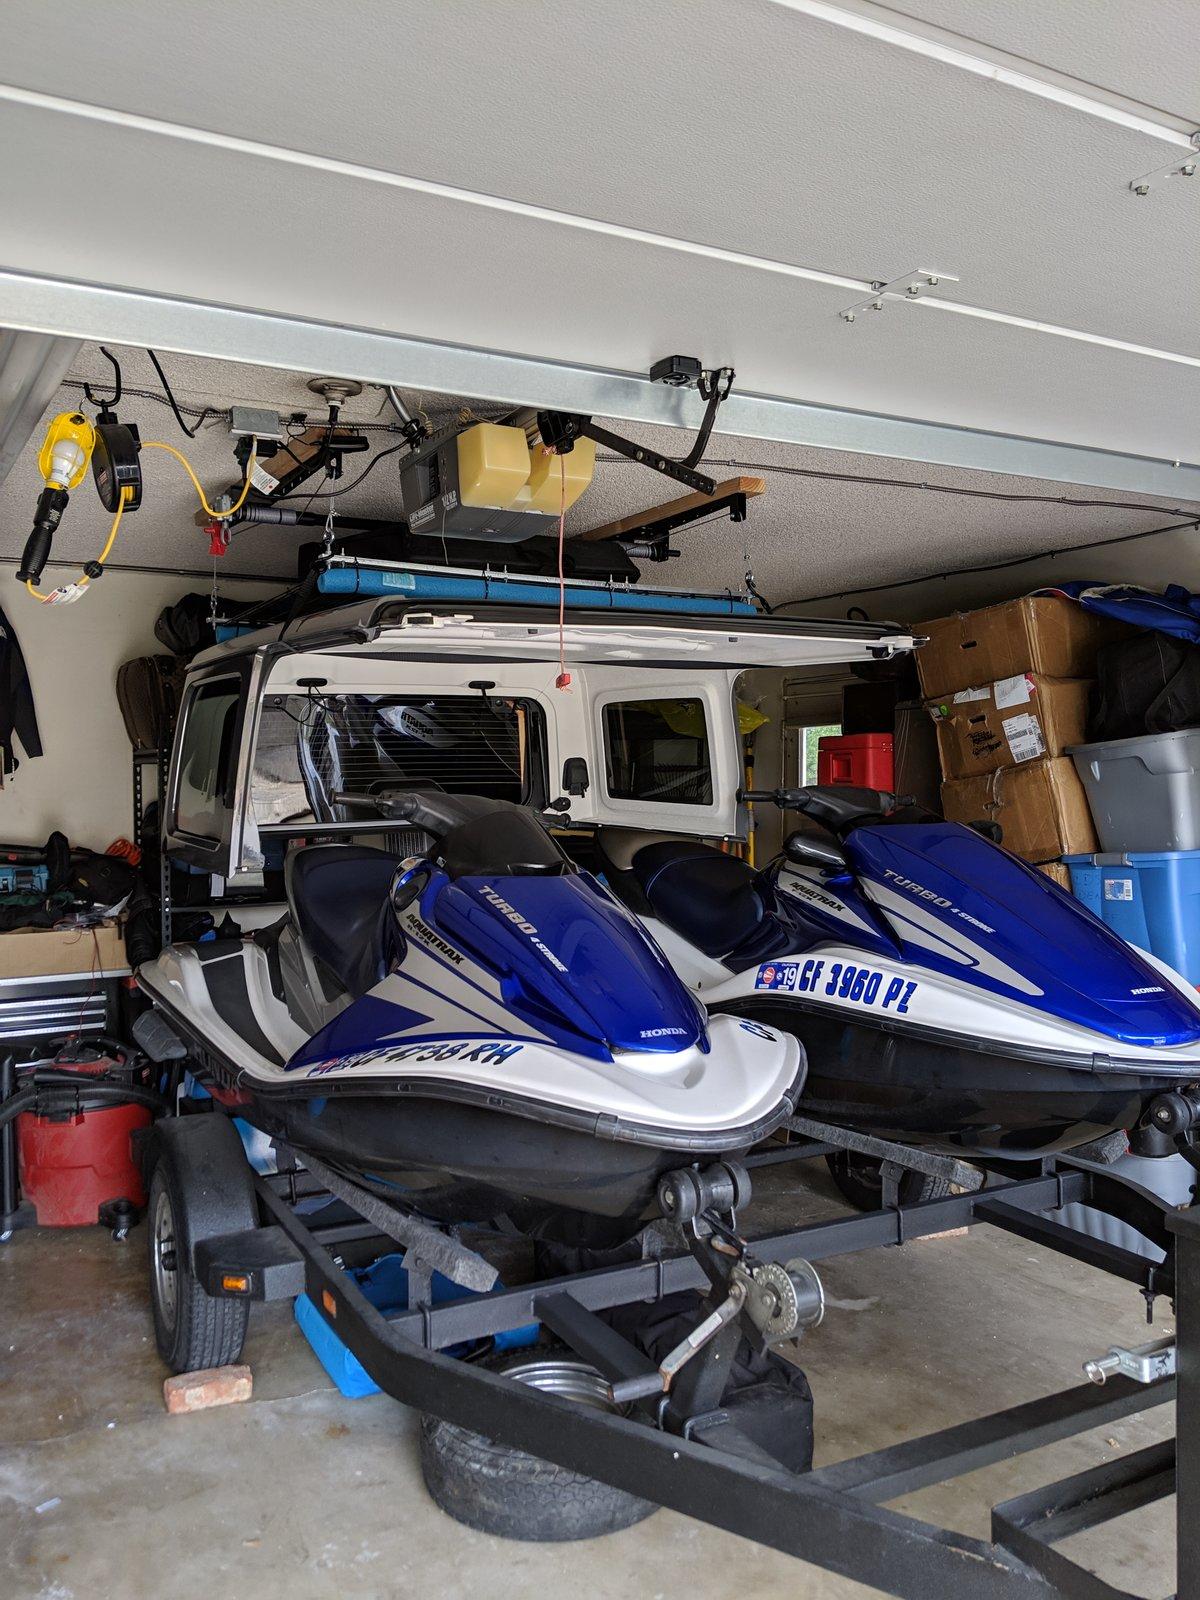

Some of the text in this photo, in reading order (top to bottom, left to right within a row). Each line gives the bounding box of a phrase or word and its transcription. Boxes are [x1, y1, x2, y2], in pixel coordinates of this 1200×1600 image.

[478, 885, 538, 935] TURBO
[789, 881, 846, 912] AQUATRAX
[883, 869, 953, 909] TURBO
[958, 911, 997, 934] STROKE
[406, 913, 466, 965] AQUATRAX
[783, 967, 797, 986] 19
[798, 959, 919, 1014] CF 3960 PZ
[1130, 986, 1166, 996] HONDA
[640, 1027, 688, 1039] HONDA
[458, 1042, 525, 1066] RH
